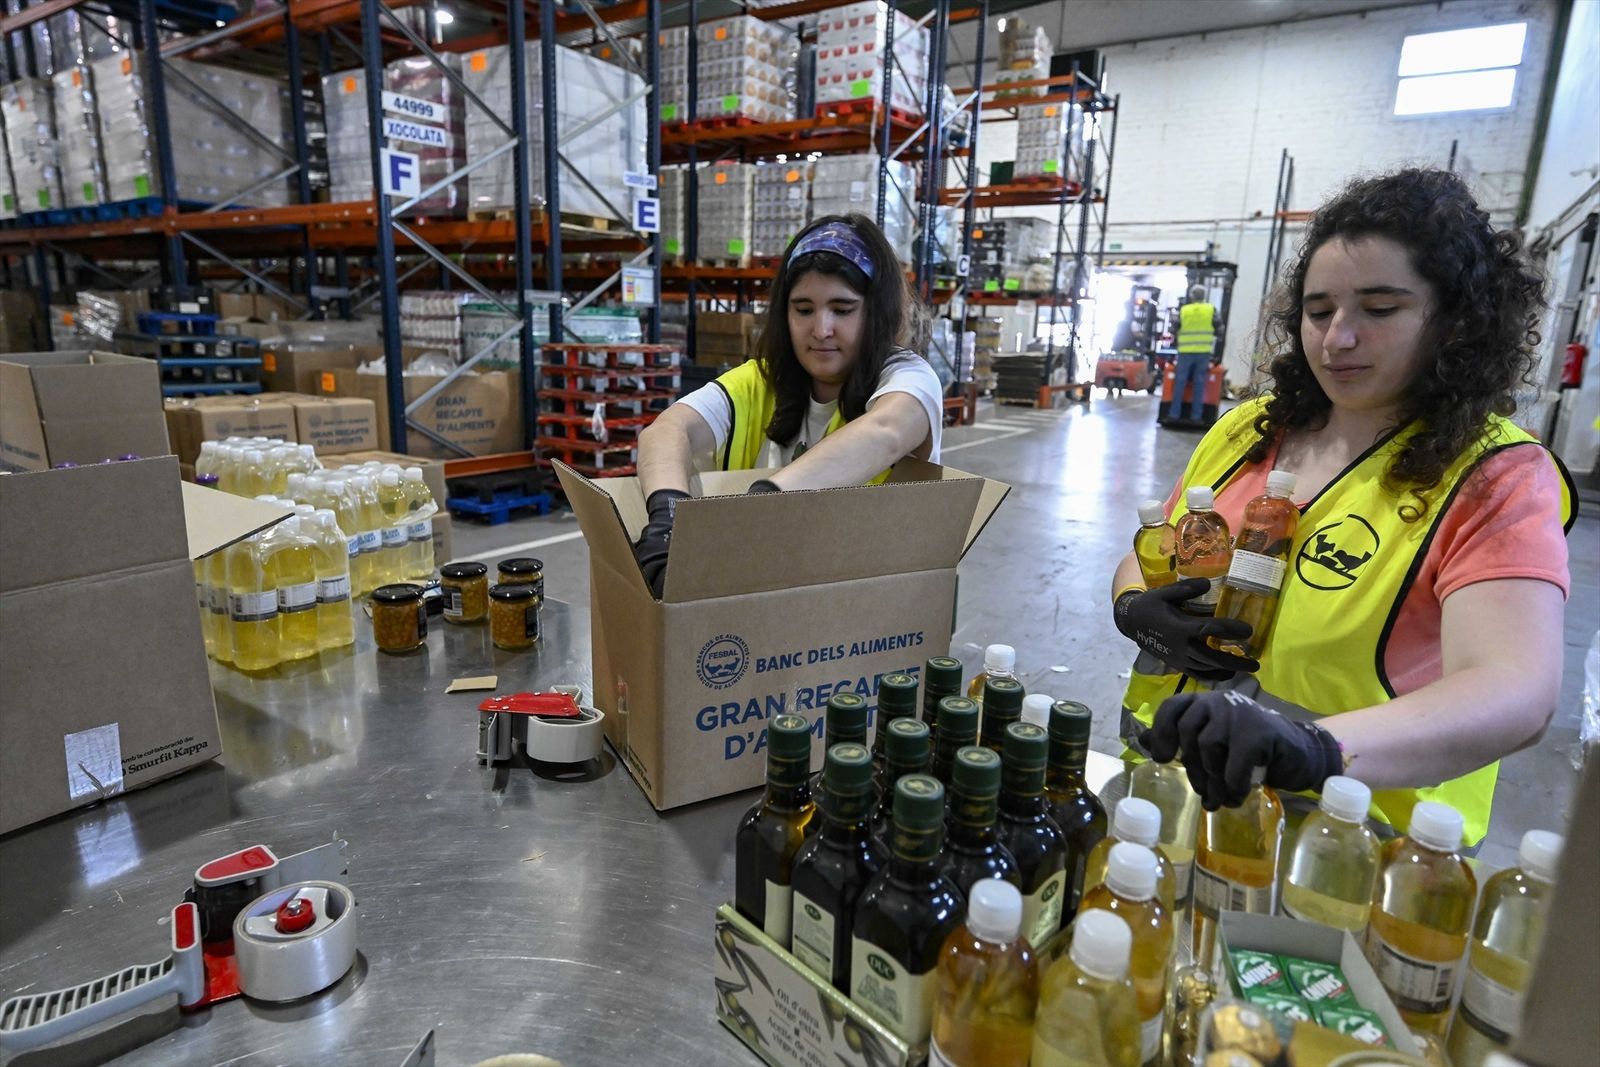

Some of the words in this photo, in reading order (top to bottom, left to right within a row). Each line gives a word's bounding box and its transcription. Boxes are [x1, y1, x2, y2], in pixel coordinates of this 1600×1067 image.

[388, 122, 443, 143] XOCOLATA
[390, 154, 412, 191] F
[638, 200, 656, 228] E
[436, 396, 466, 407] GRAN
[436, 408, 484, 420] RECAPTE
[436, 420, 496, 433] D'ALIMENTS
[708, 649, 738, 660] FESBAL
[755, 651, 803, 674] BANC
[807, 644, 845, 665] DELS
[848, 631, 924, 657] ALIMENTS
[1137, 630, 1169, 655] HyFlex
[696, 692, 786, 731] GRAN
[128, 752, 173, 775] Smurfit
[174, 741, 208, 760] Kappa
